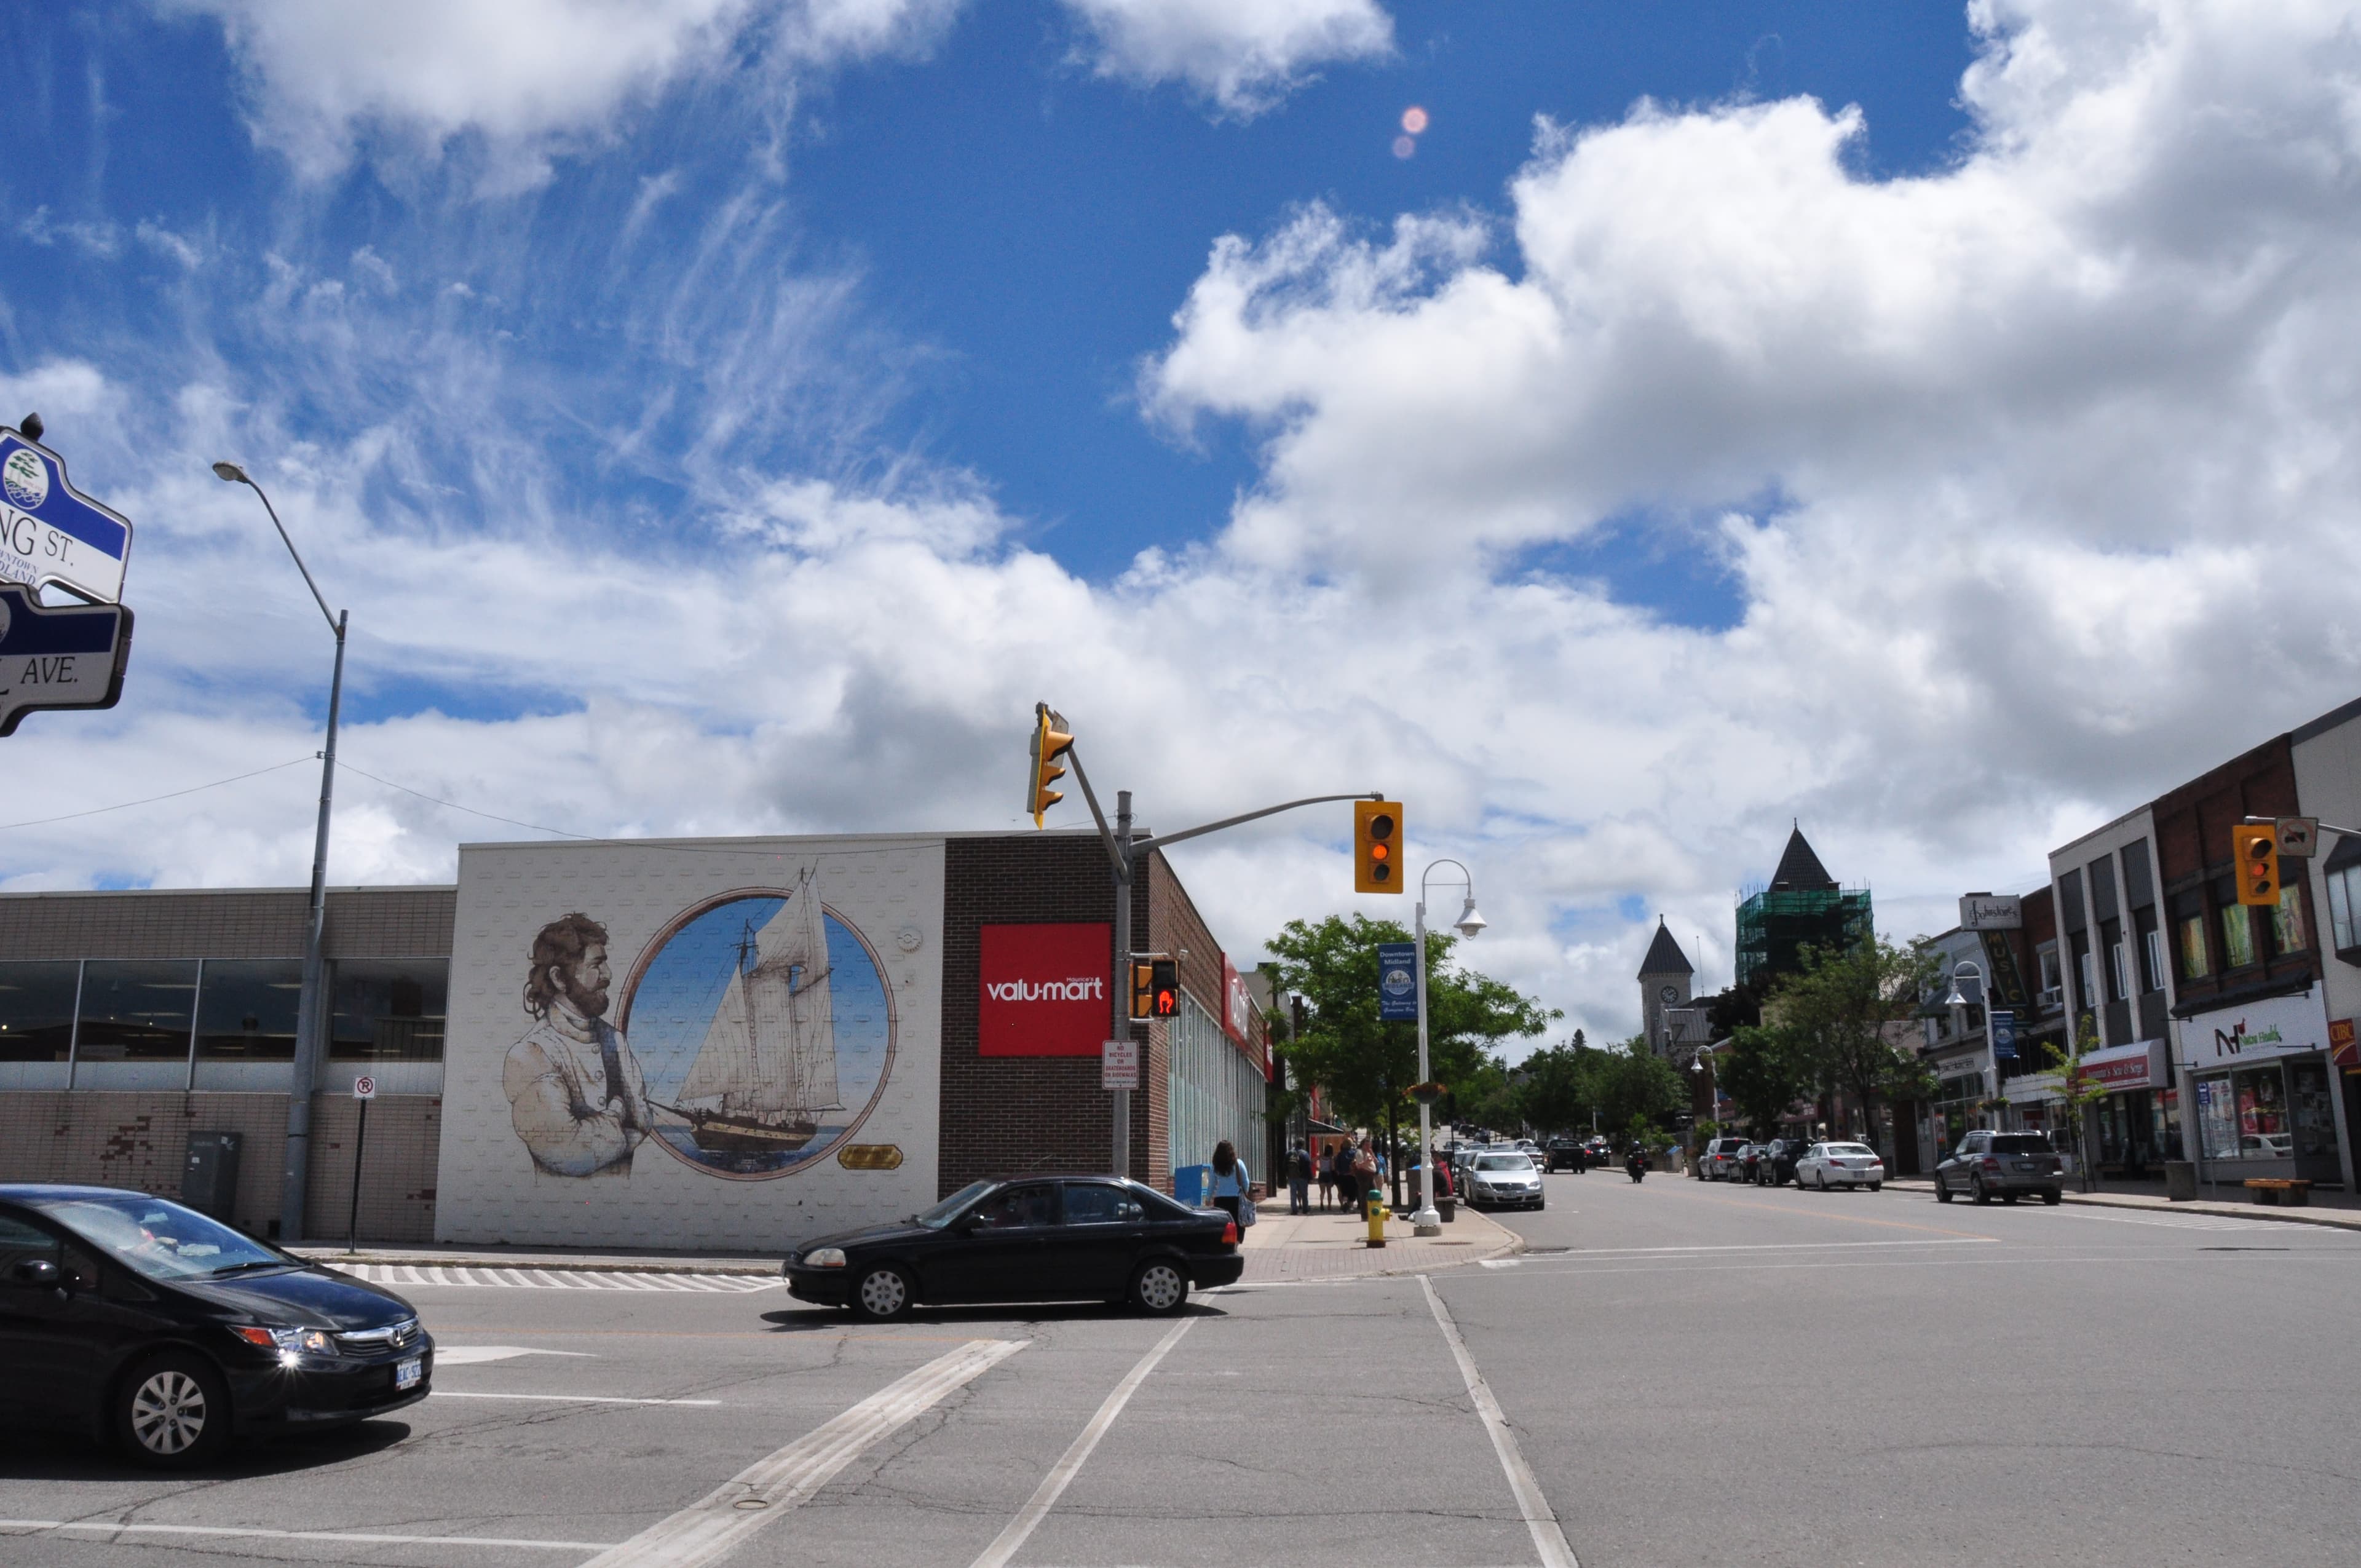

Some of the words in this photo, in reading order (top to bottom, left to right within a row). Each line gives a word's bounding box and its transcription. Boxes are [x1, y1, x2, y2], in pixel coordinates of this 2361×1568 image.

[45, 530, 73, 566] ST.
[20, 656, 78, 684] AVE.
[2331, 1023, 2353, 1042] CIBC
